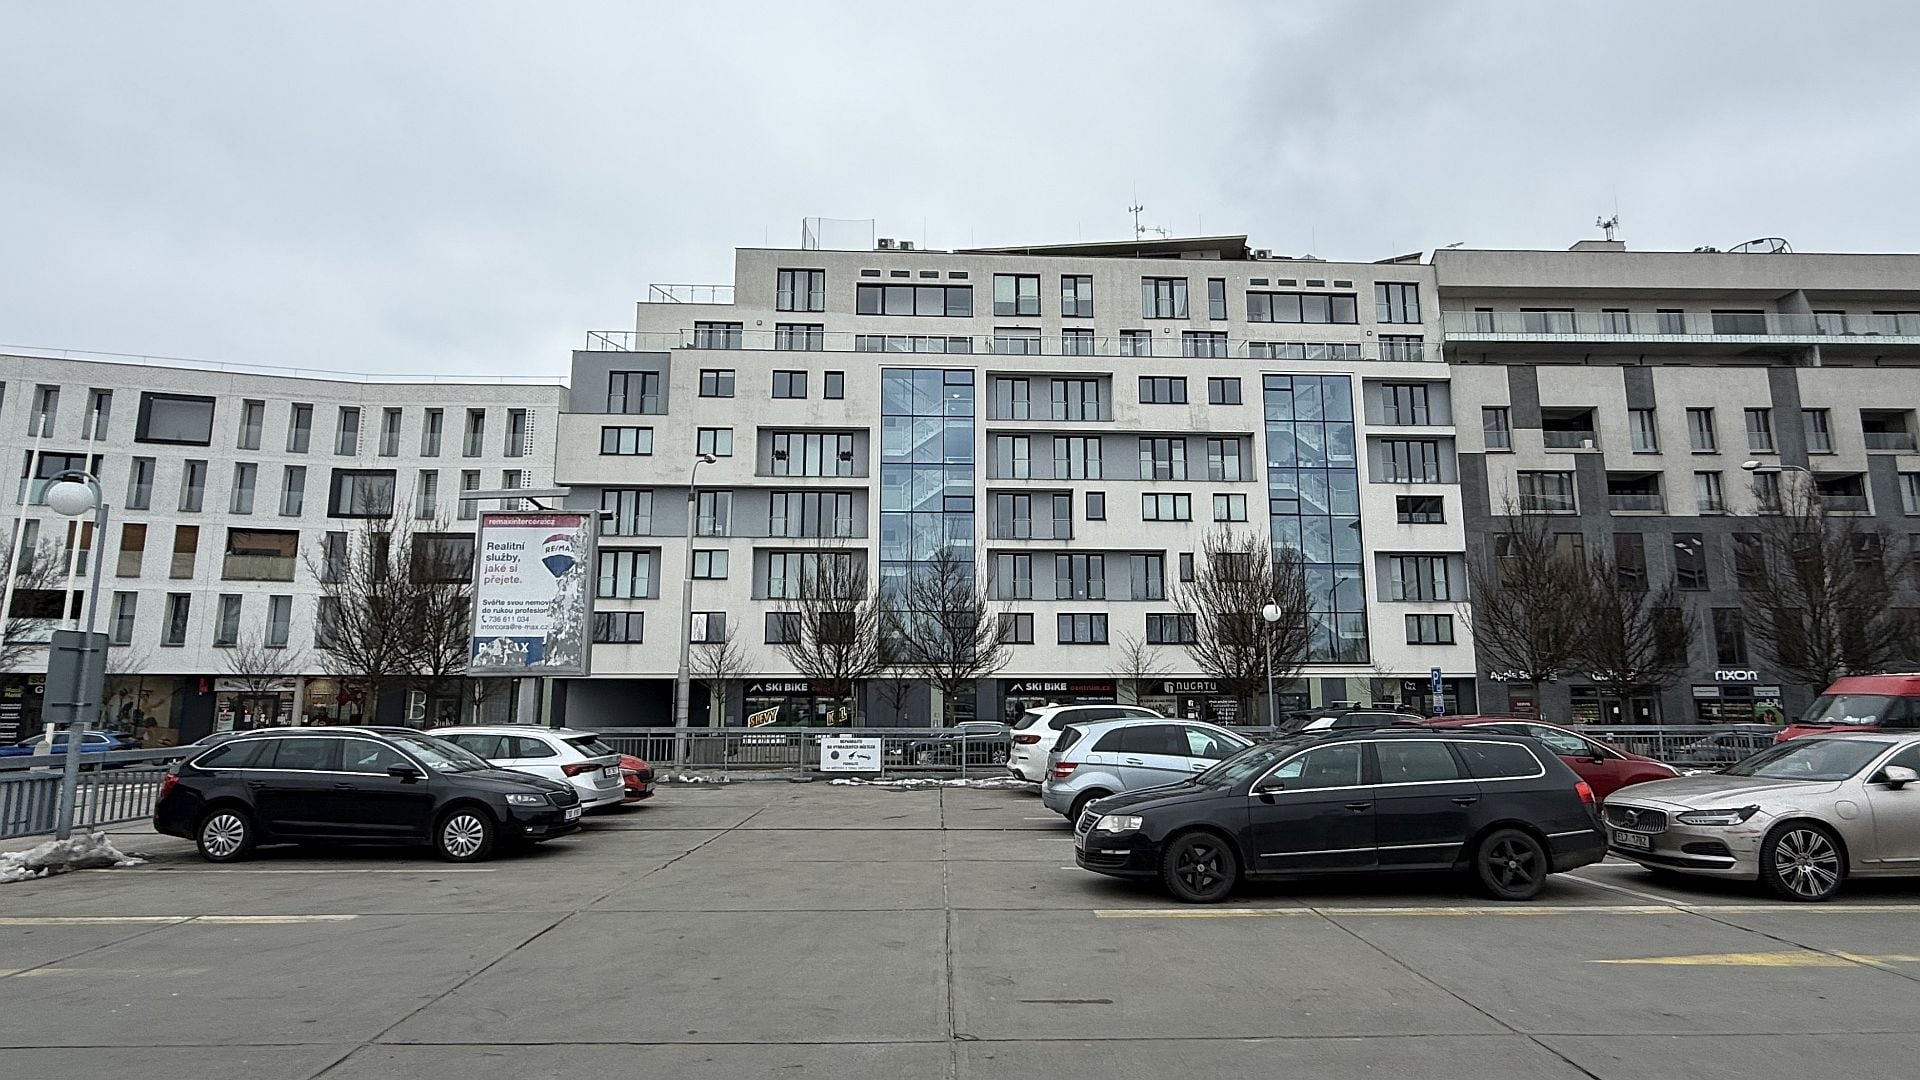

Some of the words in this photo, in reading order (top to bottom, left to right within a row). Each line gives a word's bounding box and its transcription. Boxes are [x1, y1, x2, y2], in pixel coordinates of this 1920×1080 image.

[486, 542, 525, 551] Realitní
[486, 553, 521, 563] služby,
[484, 564, 507, 574] jaké
[509, 564, 518, 573] si
[484, 576, 523, 586] přejete.
[1432, 671, 1439, 686] P
[1490, 671, 1517, 682] Apple
[1176, 682, 1217, 690] NUGATU
[750, 710, 776, 726] SLEVY
